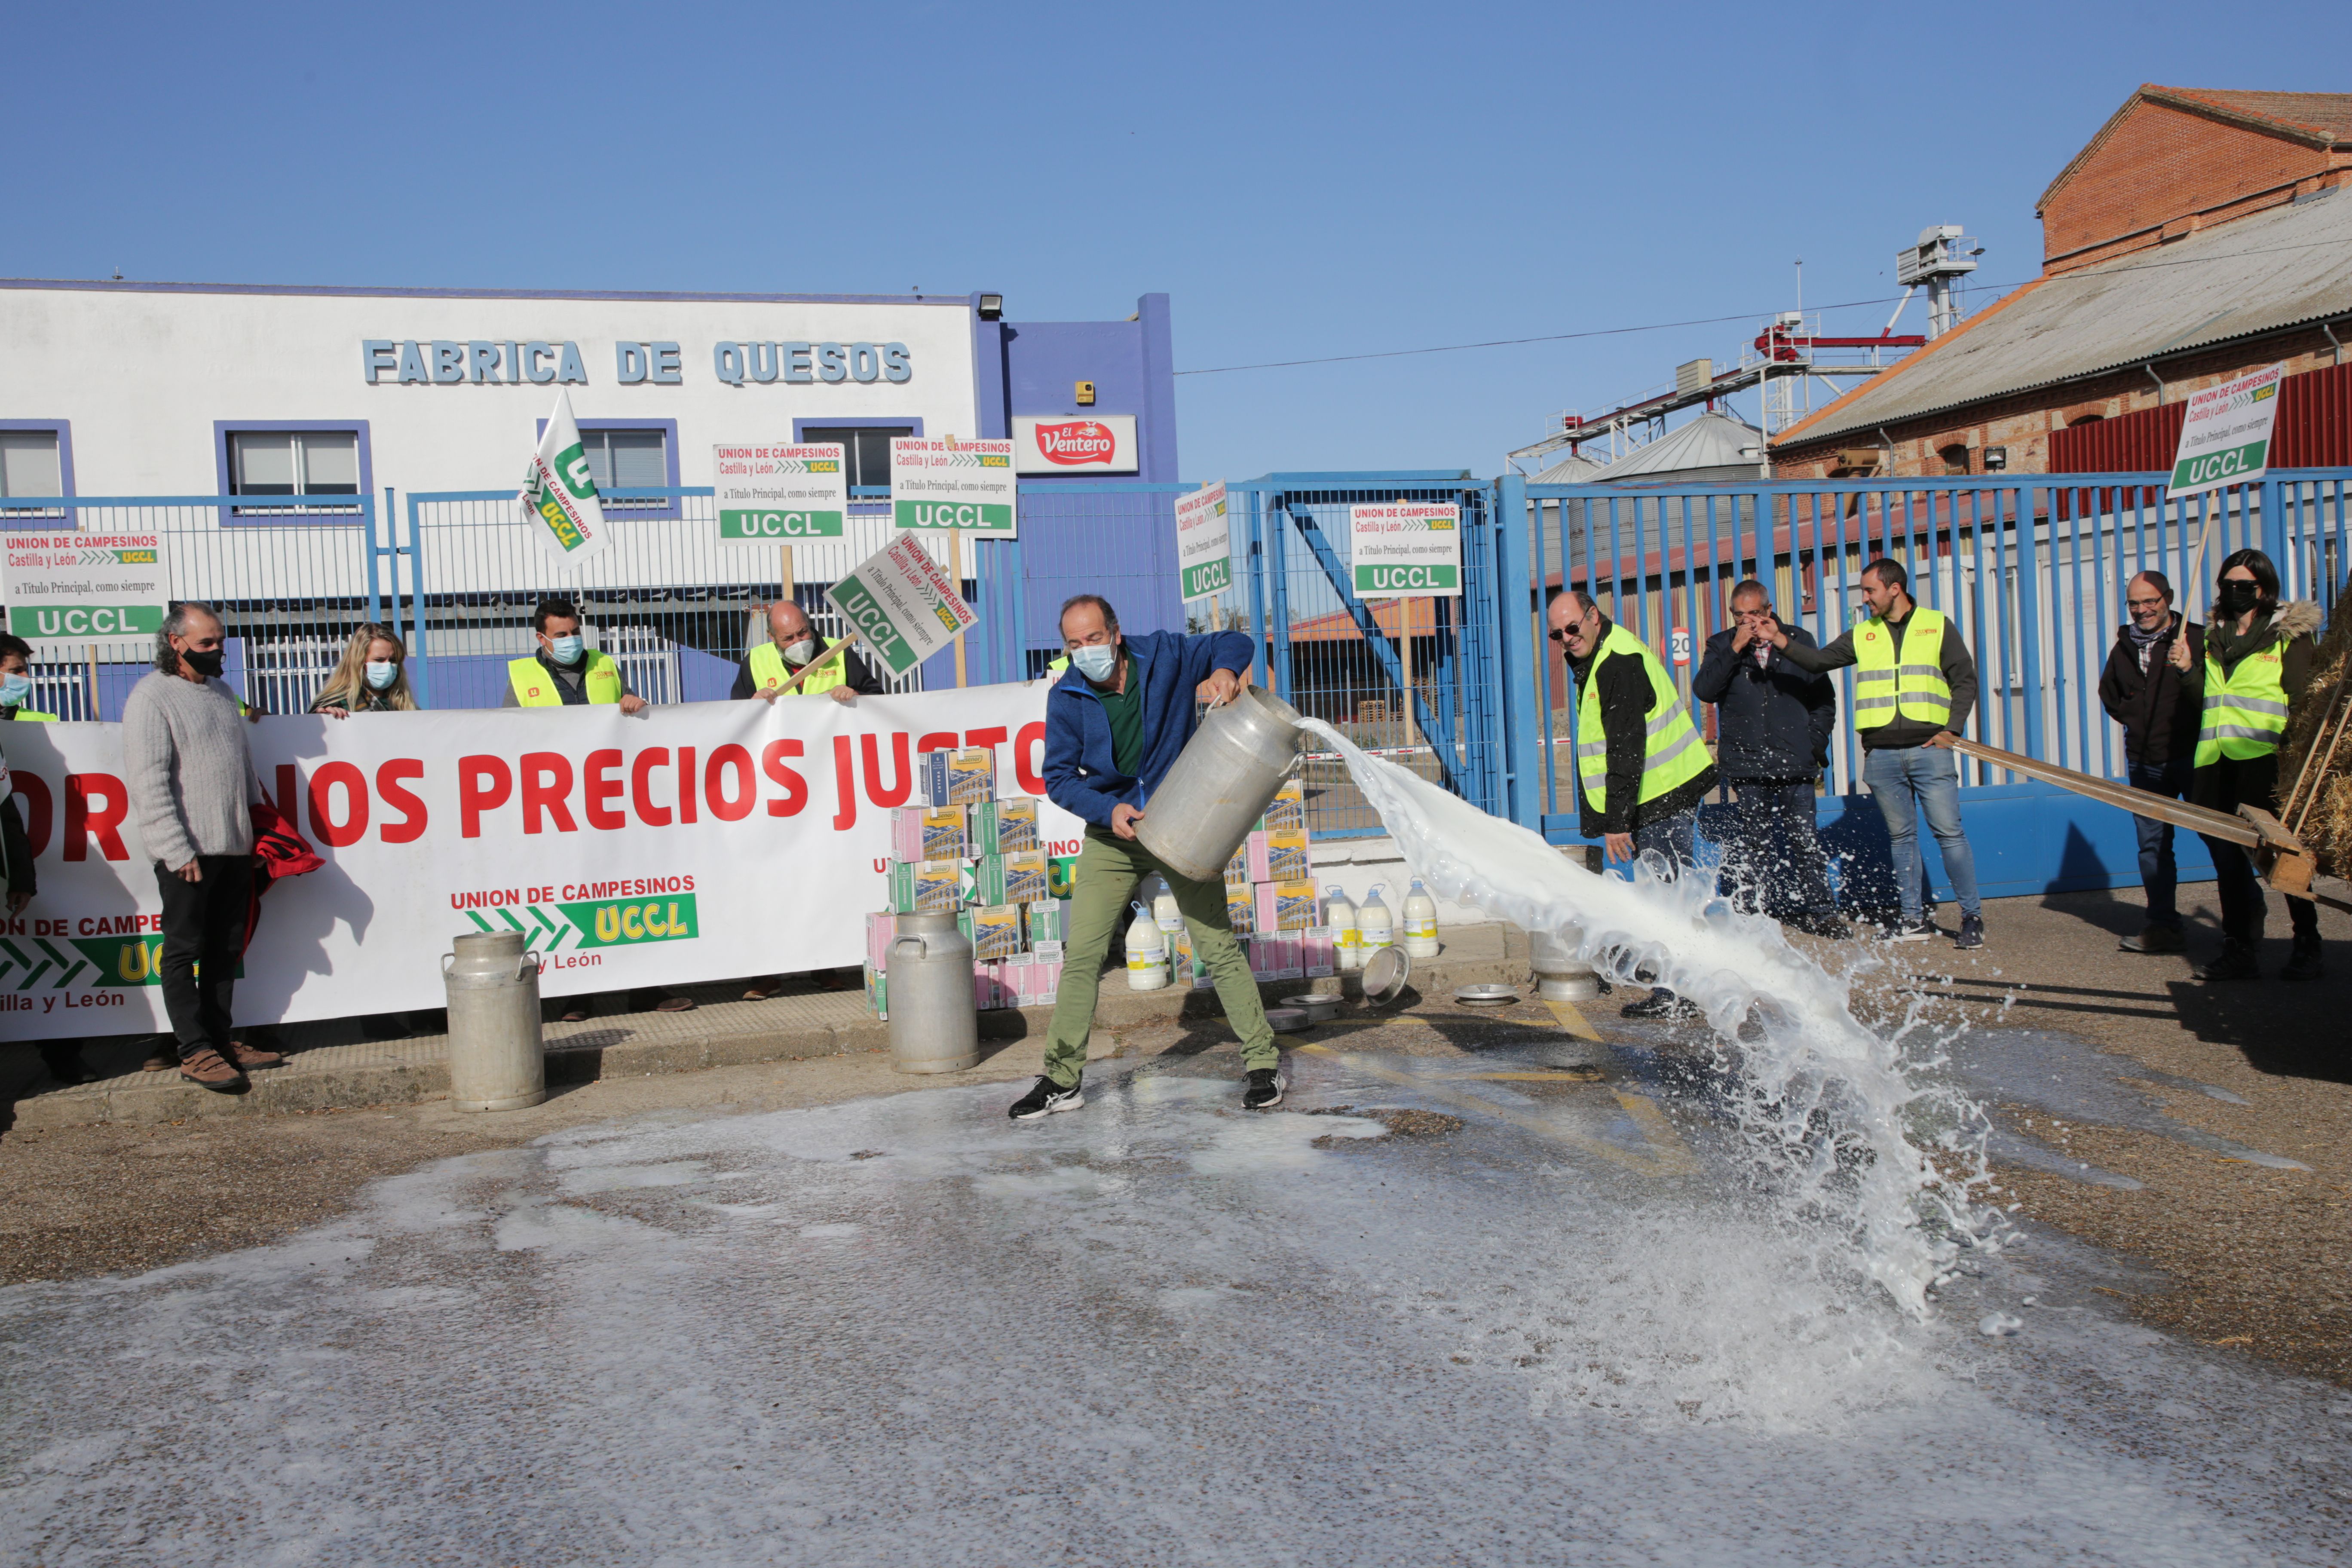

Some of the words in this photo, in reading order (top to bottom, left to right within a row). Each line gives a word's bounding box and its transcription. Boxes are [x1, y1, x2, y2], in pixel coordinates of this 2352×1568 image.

[362, 340, 587, 382] FABRICA
[616, 341, 680, 382] DE
[714, 341, 911, 384] QUESOS
[2192, 390, 2218, 406] UNION
[2219, 386, 2230, 398] DE
[2231, 368, 2279, 394] CAMPESINOS
[2255, 385, 2274, 401] UCCL
[2189, 407, 2209, 423] Castilla
[2210, 407, 2215, 420] y
[2215, 401, 2228, 415] León
[1062, 427, 1072, 437] El
[2190, 433, 2205, 447] Título
[2232, 424, 2246, 435] como
[2248, 416, 2268, 431] siempre
[719, 448, 753, 458] UNION
[756, 448, 769, 458] DE
[773, 447, 839, 458] CAMPESINOS
[896, 441, 928, 450] UNION
[931, 442, 944, 451] DE
[1041, 432, 1110, 453] Ventero
[720, 462, 747, 474] Castilla
[749, 465, 753, 477] y
[756, 462, 773, 474] León
[810, 461, 836, 472] UCCL
[897, 454, 922, 466] Castilla
[925, 457, 928, 469] y
[931, 455, 948, 466] León
[983, 457, 1007, 467] UCCL
[2189, 448, 2248, 483] UCCL
[729, 488, 751, 499] Título
[753, 488, 786, 501] Principal,
[788, 490, 806, 498] como
[808, 488, 836, 500] siempre
[905, 479, 925, 490] Título
[927, 480, 960, 493] Principal,
[980, 481, 1007, 493] siempre
[522, 494, 535, 515] León
[540, 467, 551, 481] DE
[549, 481, 592, 539] CAMPESINOS
[1178, 500, 1194, 515] UNION
[1194, 497, 1201, 509] DE
[1355, 508, 1384, 518] UNION
[1387, 508, 1398, 517] DE
[1400, 507, 1455, 517] CAMPESINOS
[541, 502, 578, 547] UCCL
[741, 514, 821, 535] UCCL
[916, 505, 992, 527] UCCL
[1431, 520, 1452, 529] UCCL
[1356, 522, 1379, 533] Castilla
[1381, 524, 1384, 534] y
[1386, 521, 1401, 531] León
[6, 538, 49, 549] UNION
[54, 537, 70, 548] DE
[74, 536, 157, 548] CAMPESINOS
[1364, 545, 1381, 555] Título
[1384, 545, 1411, 556] Principal,
[1429, 544, 1452, 555] siempre
[9, 554, 43, 567] Castilla
[46, 557, 51, 569] y
[55, 553, 77, 566] León
[122, 551, 154, 563] UCCL
[888, 545, 909, 571] Castilla
[900, 567, 910, 576] y
[907, 570, 922, 588] León
[901, 536, 925, 563] UNION
[921, 561, 935, 576] DE
[929, 571, 972, 624] CAMPESINOS
[1193, 562, 1227, 592] UCCL
[1373, 567, 1439, 588] UCCL
[22, 582, 49, 594] Título
[51, 581, 93, 596] Principal,
[96, 583, 119, 593] como
[121, 581, 155, 594] siempre
[871, 568, 888, 590] Título
[902, 608, 916, 626] como
[913, 622, 934, 646] siempre
[37, 609, 138, 634] UCCL
[846, 592, 899, 657] UCCL
[936, 606, 957, 631] UCCL
[1672, 638, 1689, 653] 20
[458, 739, 808, 838] PRECIOS
[451, 888, 519, 910] UNION
[527, 886, 554, 904] DE
[562, 875, 695, 900] CAMPESINOS
[35, 919, 68, 936] DE
[595, 903, 687, 942] UCCL
[554, 952, 602, 970] León
[43, 996, 56, 1014] y
[66, 990, 124, 1008] León
